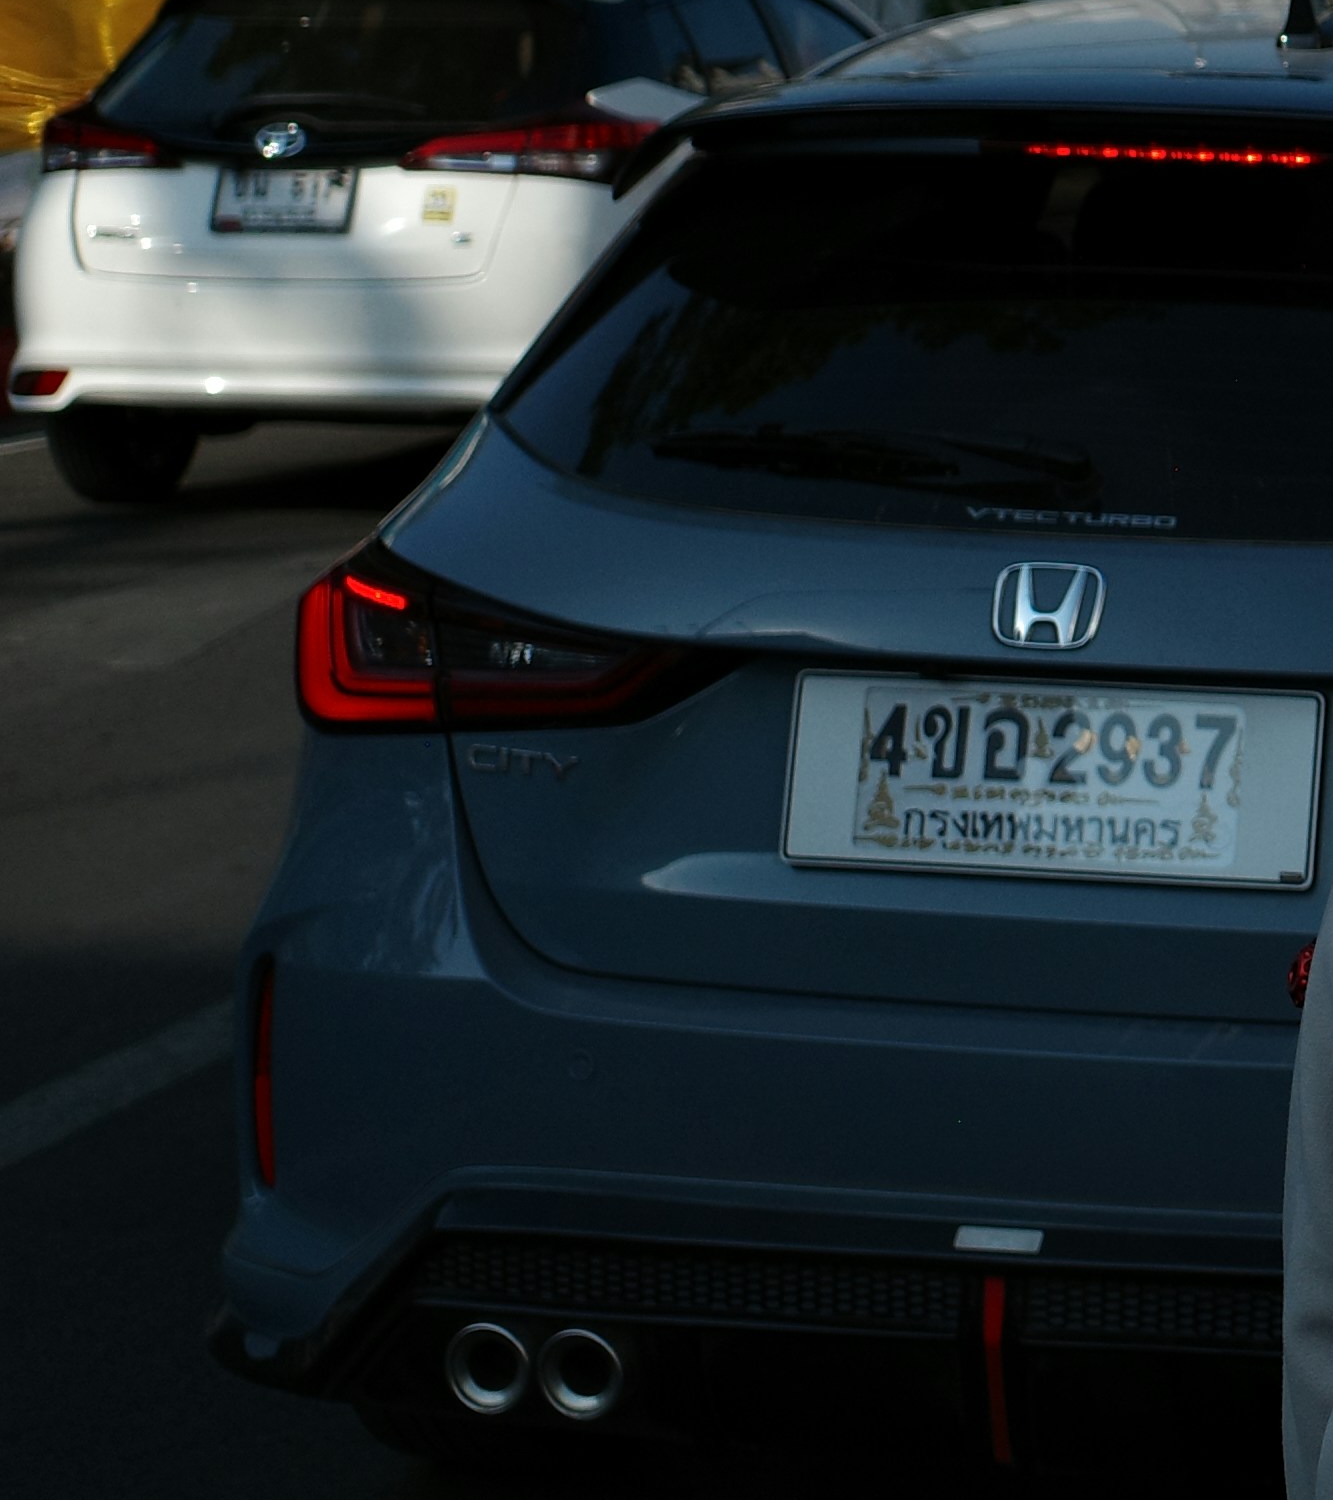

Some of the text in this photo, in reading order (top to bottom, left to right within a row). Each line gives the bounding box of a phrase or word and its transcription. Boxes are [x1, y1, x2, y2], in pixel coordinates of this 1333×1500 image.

[966, 505, 1179, 531] VTEC TURBO
[467, 743, 579, 780] CITY
[1048, 708, 1239, 792] 2937
[902, 806, 1184, 850] กรุงเทพมหานคร
